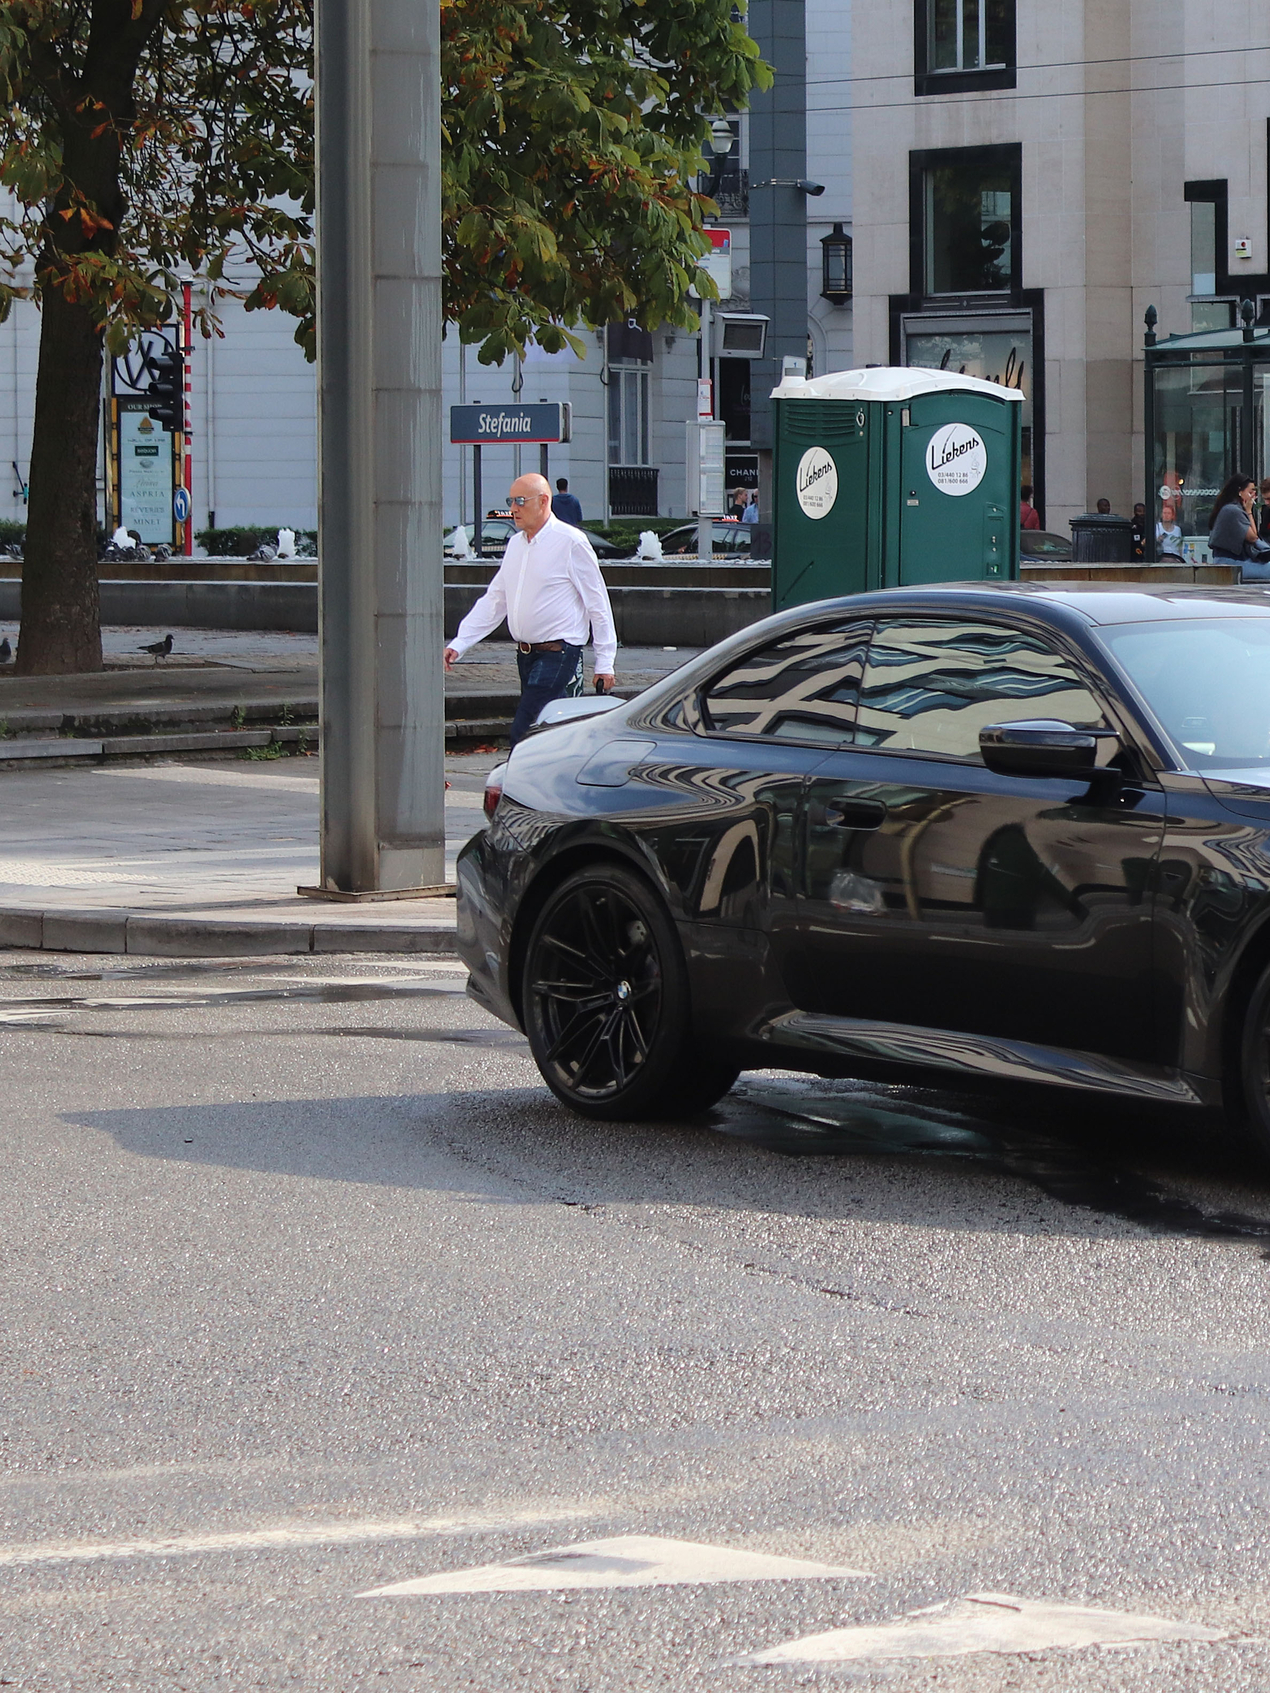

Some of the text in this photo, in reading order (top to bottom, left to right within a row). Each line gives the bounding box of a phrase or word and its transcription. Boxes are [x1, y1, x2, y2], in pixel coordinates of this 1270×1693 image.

[478, 412, 532, 438] Stefania
[932, 426, 980, 471] Liekens
[799, 450, 833, 493] Liekens
